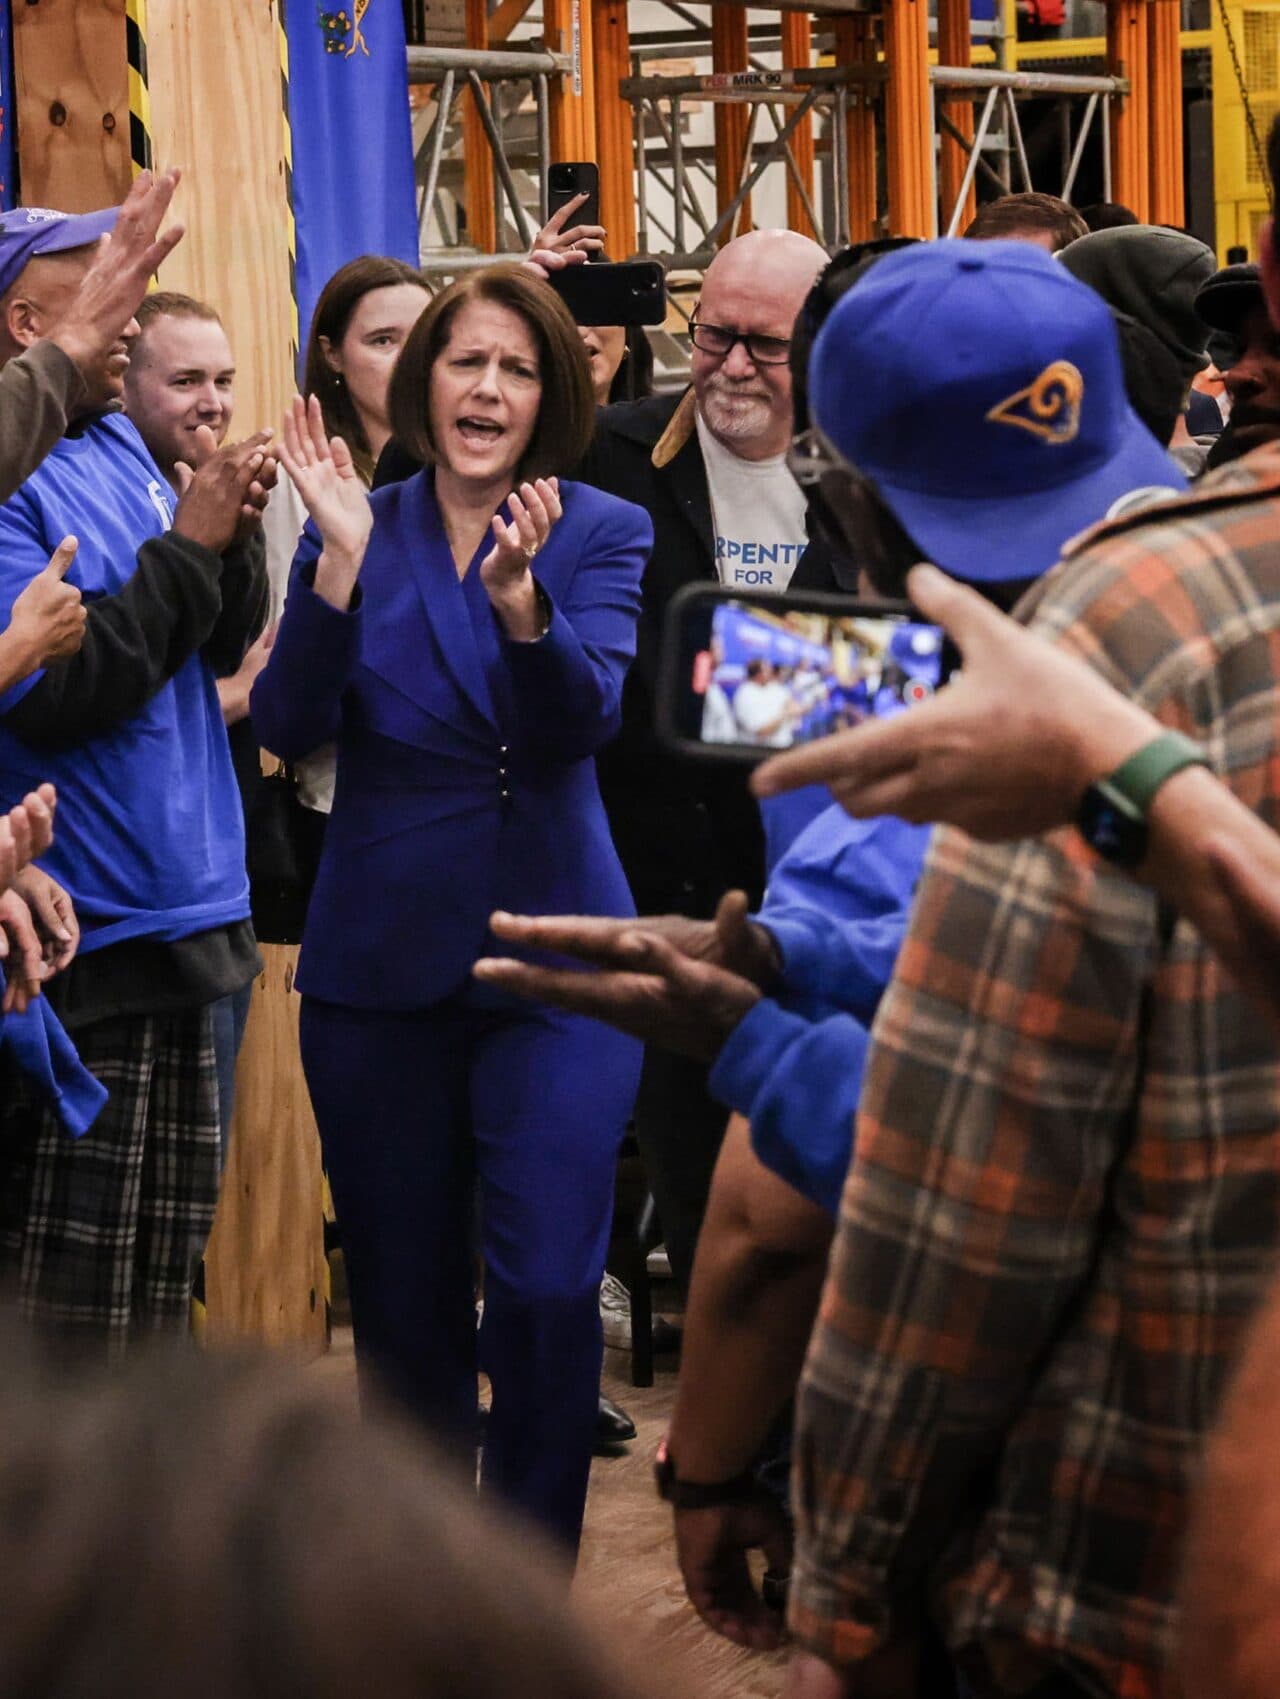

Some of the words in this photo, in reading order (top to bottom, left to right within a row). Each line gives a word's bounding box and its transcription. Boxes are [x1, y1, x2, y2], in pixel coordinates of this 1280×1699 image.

[732, 73, 763, 87] MRK
[765, 73, 782, 85] 90
[734, 569, 775, 585] FOR
